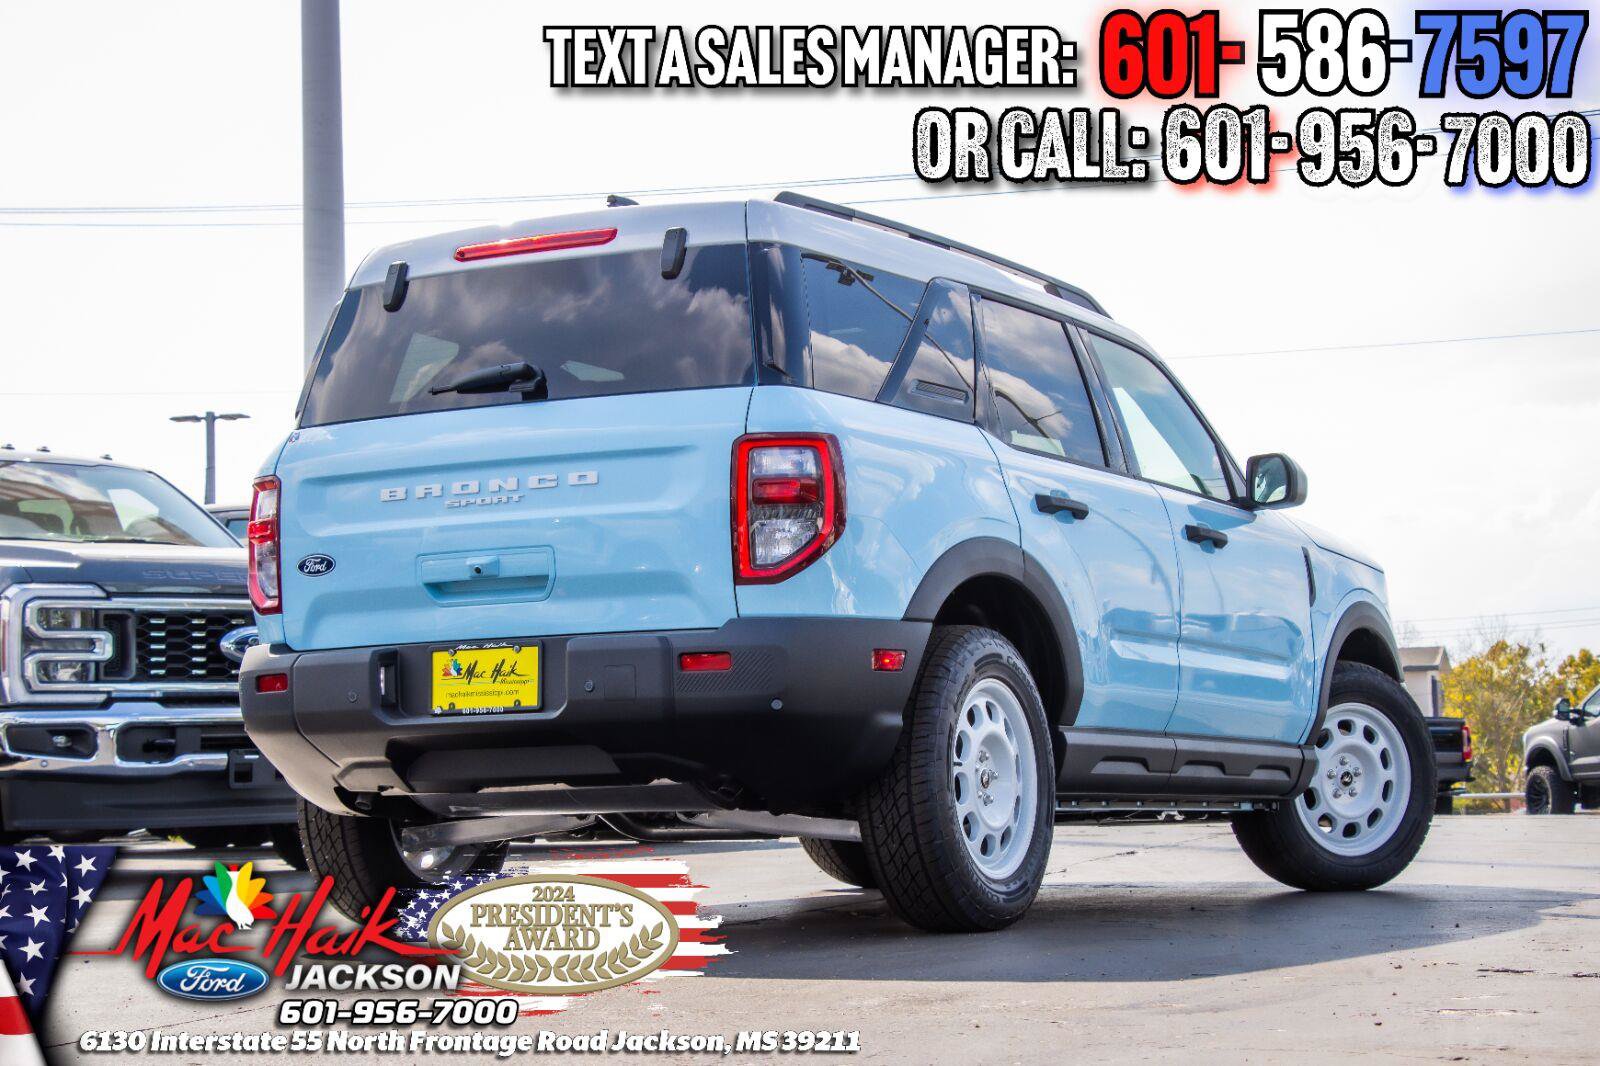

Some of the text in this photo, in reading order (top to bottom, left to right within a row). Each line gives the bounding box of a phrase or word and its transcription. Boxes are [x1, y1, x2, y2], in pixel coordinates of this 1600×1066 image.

[379, 470, 600, 502] BRONCO
[444, 494, 524, 509] SPORT
[302, 558, 329, 574] Ford
[461, 658, 526, 685] Mac Haik
